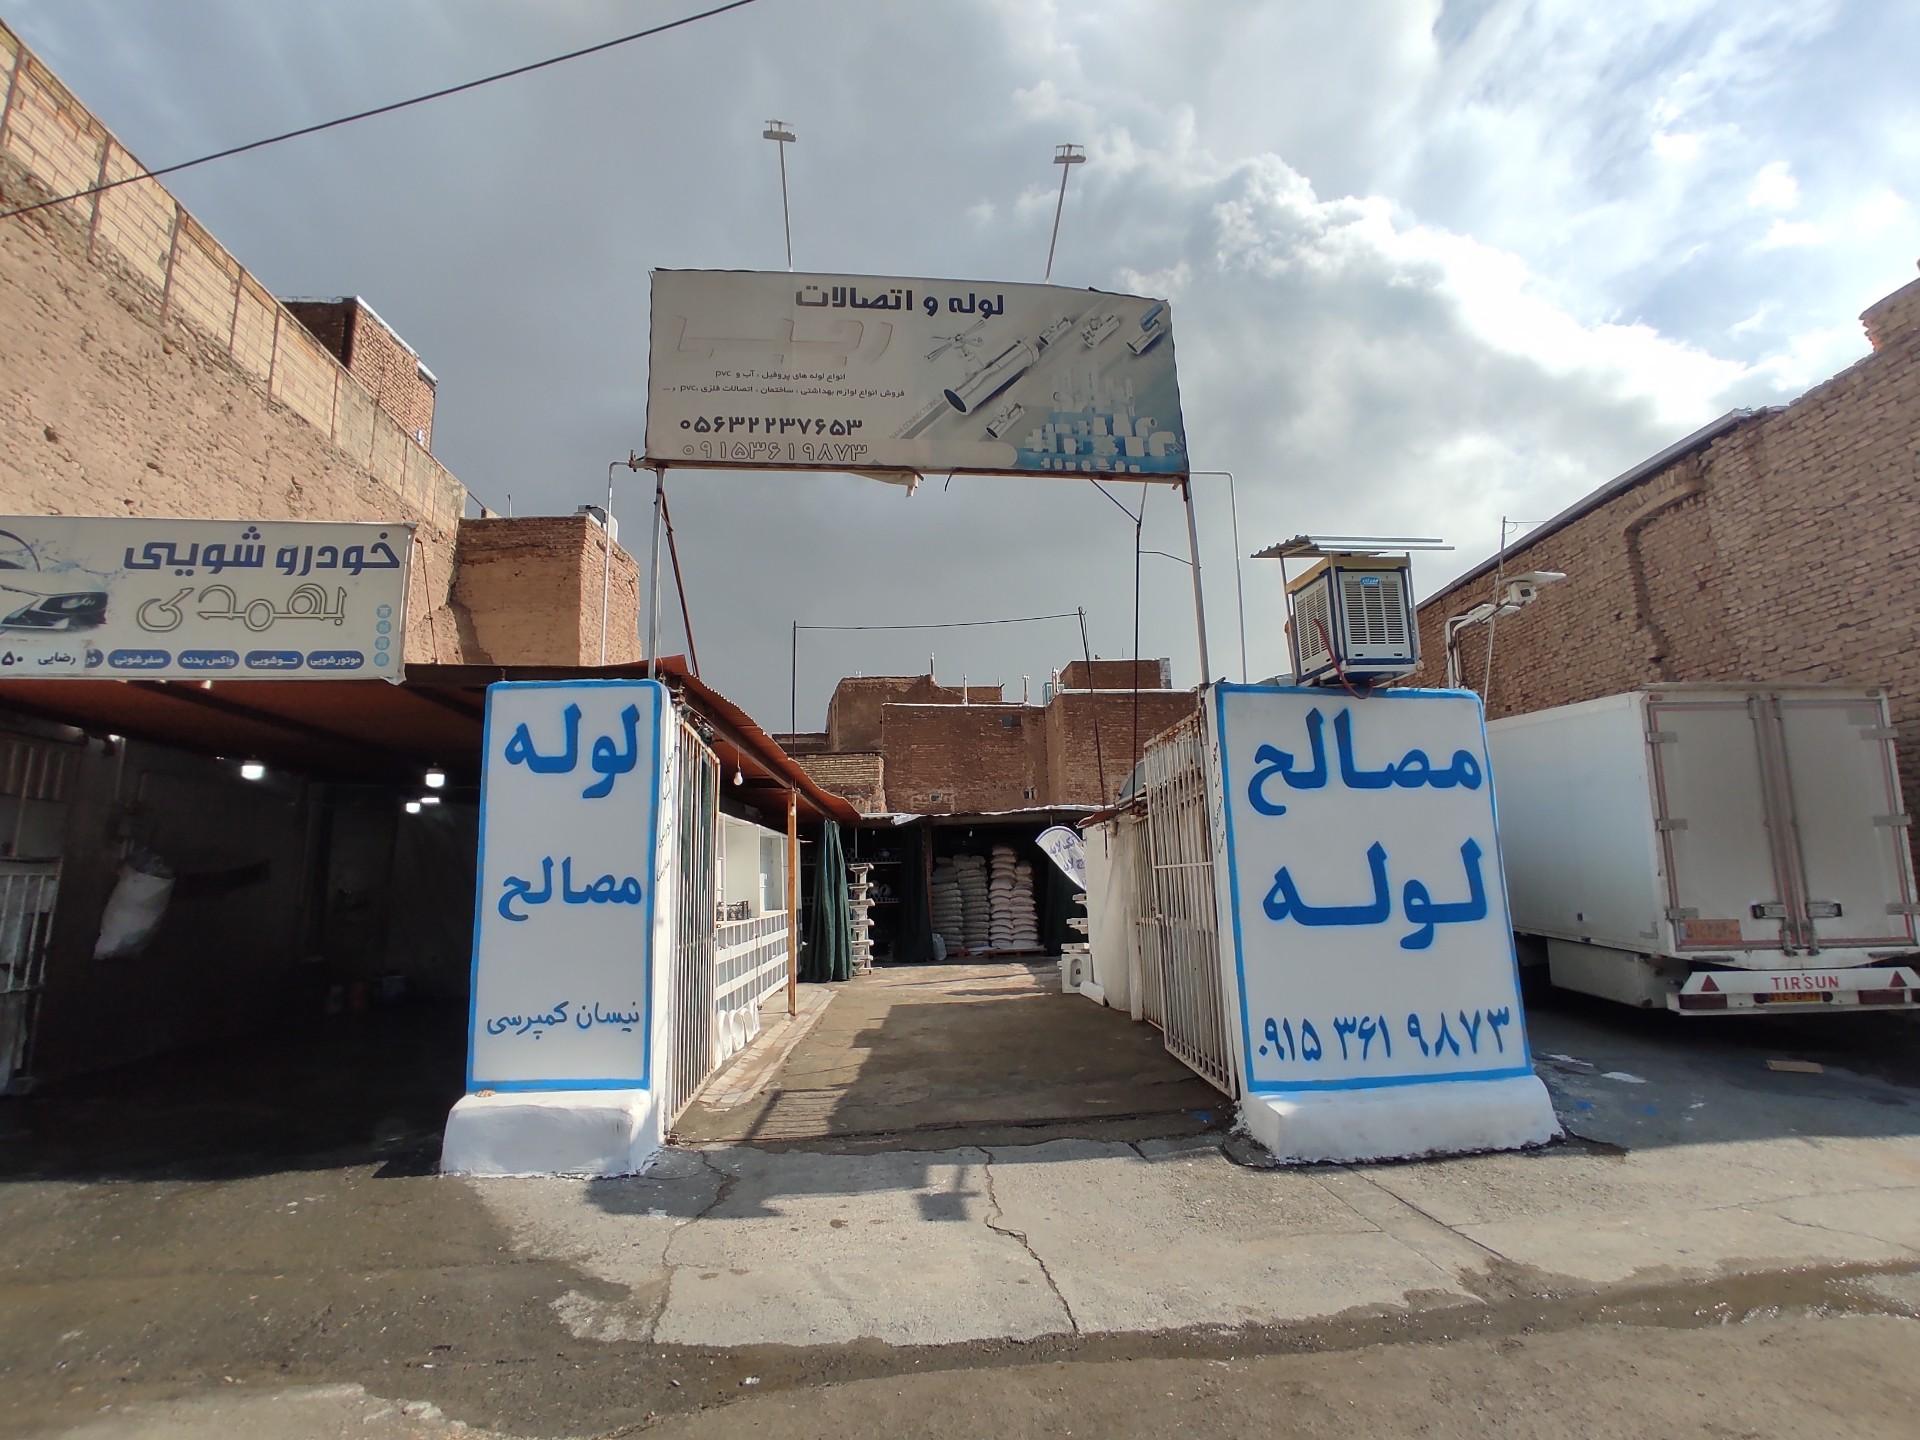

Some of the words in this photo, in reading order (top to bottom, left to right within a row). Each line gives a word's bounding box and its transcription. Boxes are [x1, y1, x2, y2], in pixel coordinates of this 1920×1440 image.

[795, 285, 912, 310] اتصالات
[922, 295, 938, 316] و
[947, 292, 1003, 319] لوله
[792, 372, 807, 380] های
[809, 372, 824, 380] لوله
[826, 372, 846, 382] انواع
[700, 384, 720, 393] فلزی
[721, 385, 752, 393] اتصالات
[800, 386, 834, 396] بهداشتی
[836, 388, 856, 397] لوازم
[858, 389, 878, 398] انواع
[880, 389, 905, 398] فروش
[124, 525, 265, 576] شویی
[276, 532, 400, 576] خودرو
[37, 652, 76, 665] رضایی
[182, 655, 205, 666] بدنه
[206, 654, 235, 666] واکس
[504, 702, 639, 800] لوله
[1248, 706, 1482, 817] مصالح
[497, 856, 643, 923] مصالح
[1262, 836, 1488, 951] لوله
[1770, 975, 1839, 990] TIRSUN
[487, 1000, 569, 1039] کمپرسی
[577, 1001, 640, 1032] نیسان
[1258, 1017, 1322, 1063] ۰۹۱۵
[1333, 1013, 1392, 1060] ۳۶۱
[1407, 1006, 1510, 1058] ۹۸۷۳
